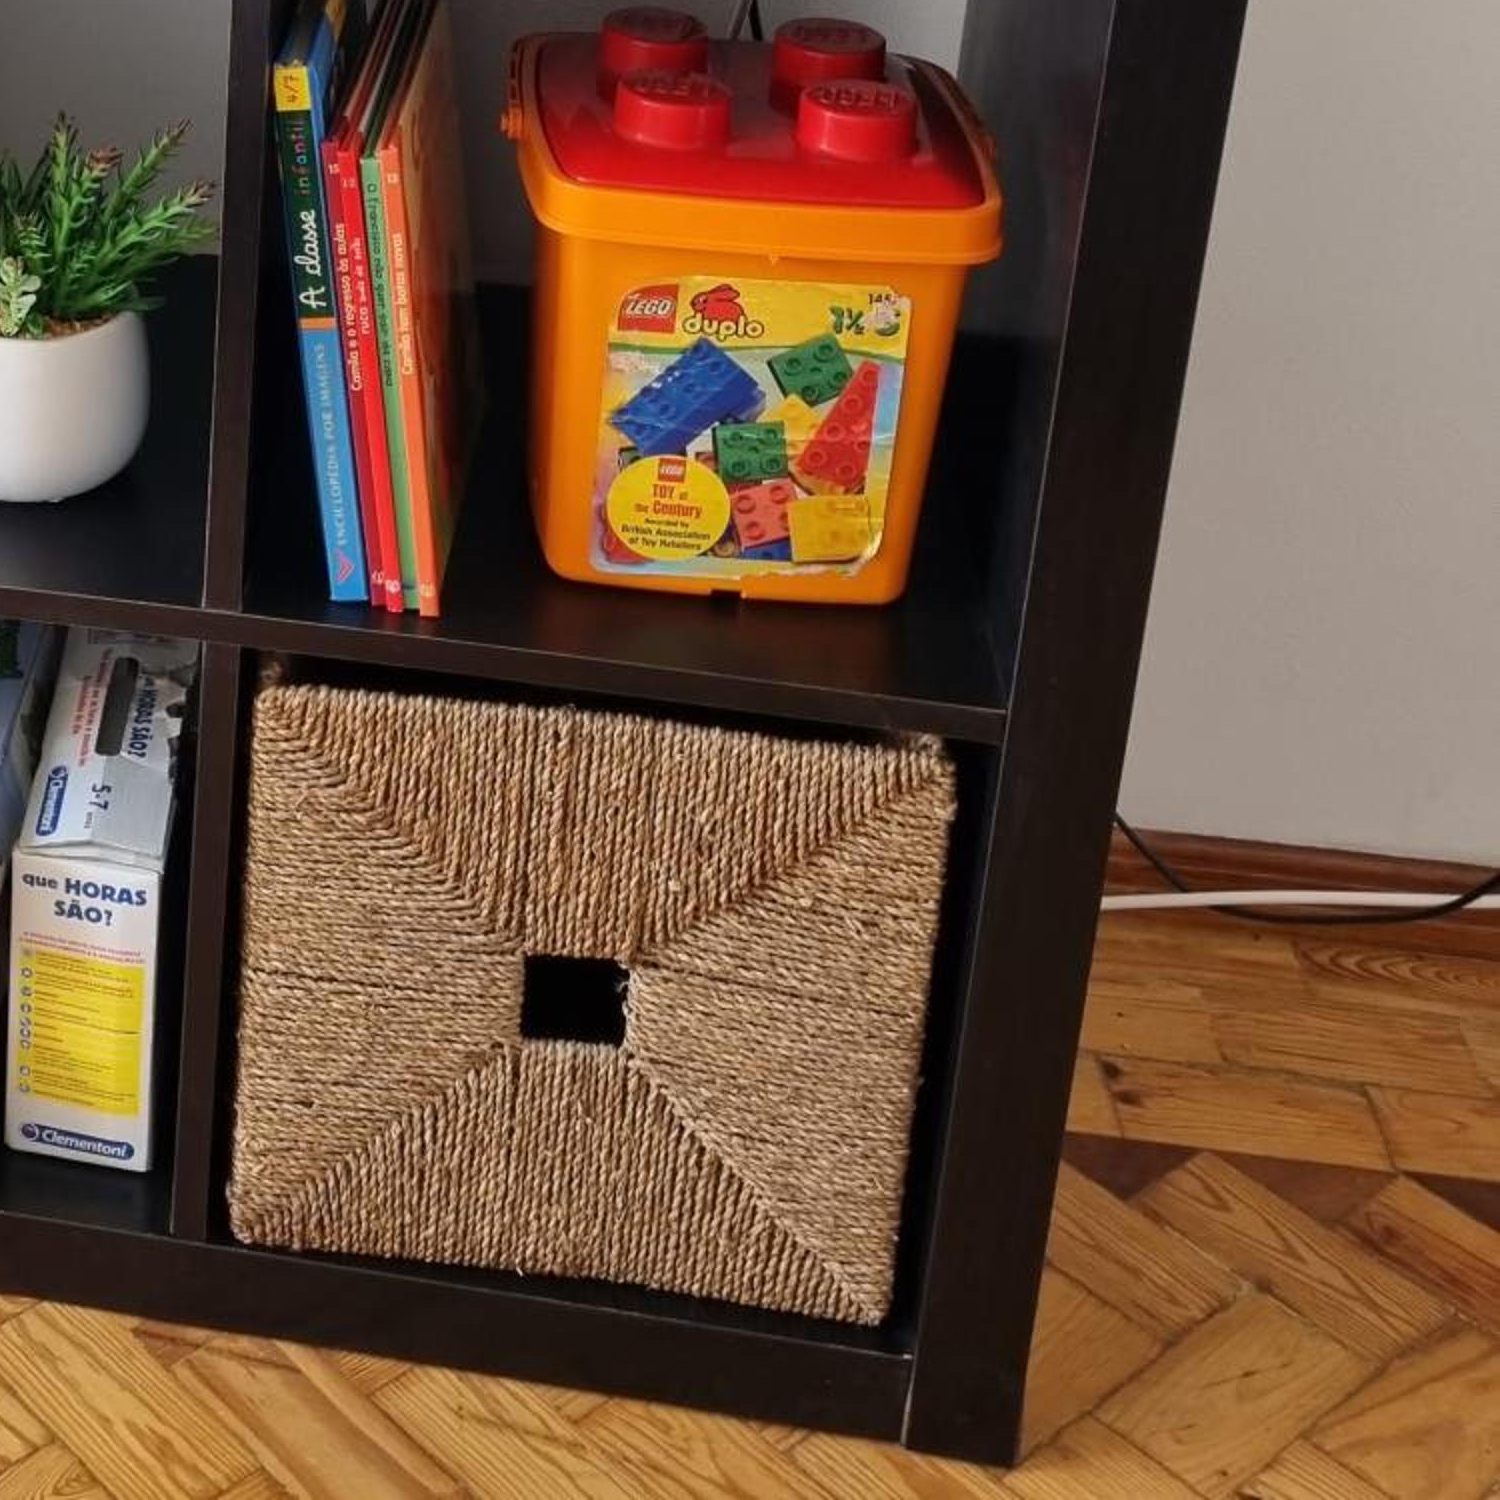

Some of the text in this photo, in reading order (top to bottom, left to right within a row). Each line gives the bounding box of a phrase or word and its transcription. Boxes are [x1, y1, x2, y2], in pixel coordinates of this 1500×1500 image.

[293, 208, 324, 277] classe
[298, 286, 327, 310] A
[626, 296, 672, 317] LEGO
[682, 312, 765, 342] duplo
[652, 483, 676, 499] TOY
[653, 499, 703, 519] Century
[621, 523, 711, 540] British Association
[128, 725, 154, 759] SÃO?
[22, 873, 148, 906] que HORAS
[54, 898, 113, 927] SÃO?
[41, 1128, 128, 1157] Clementoni
